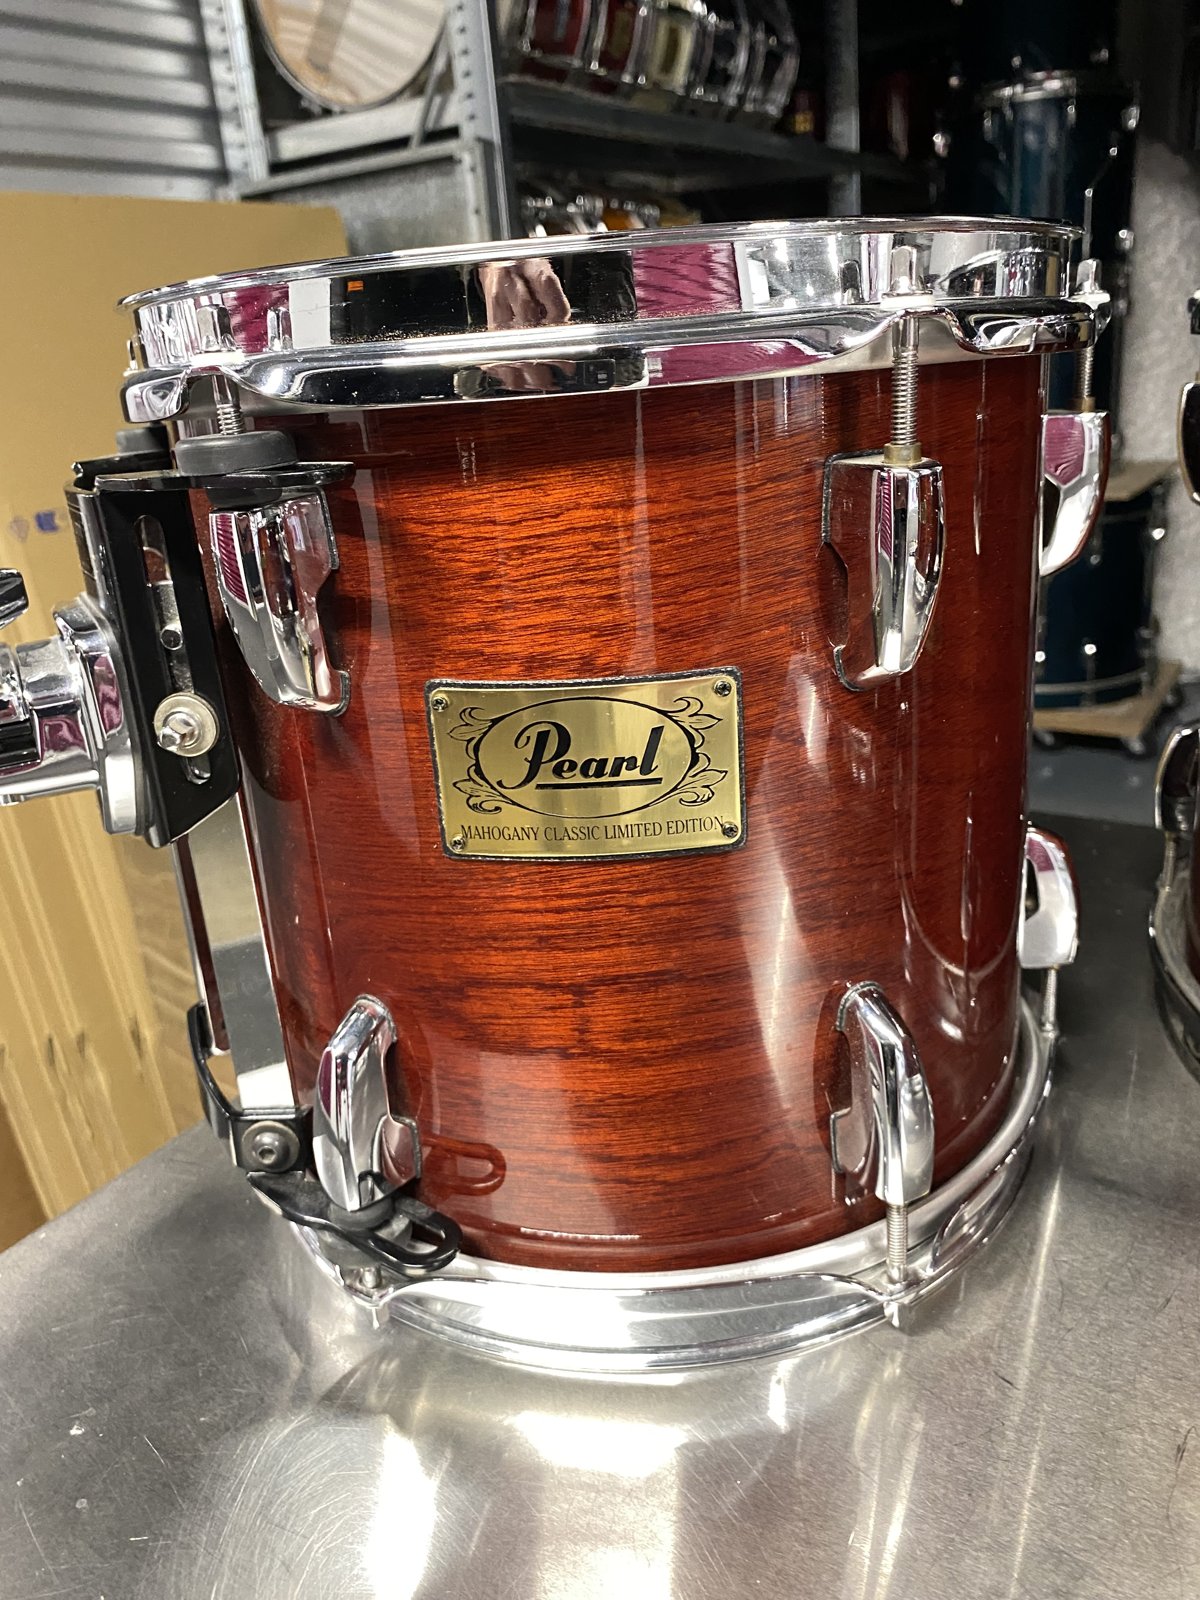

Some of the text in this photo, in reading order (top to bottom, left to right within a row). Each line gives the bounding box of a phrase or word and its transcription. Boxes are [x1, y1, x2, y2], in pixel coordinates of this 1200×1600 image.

[497, 720, 664, 790] Pearl
[460, 816, 724, 841] MAHOGANY CLASSIC LIMITED EDITION
